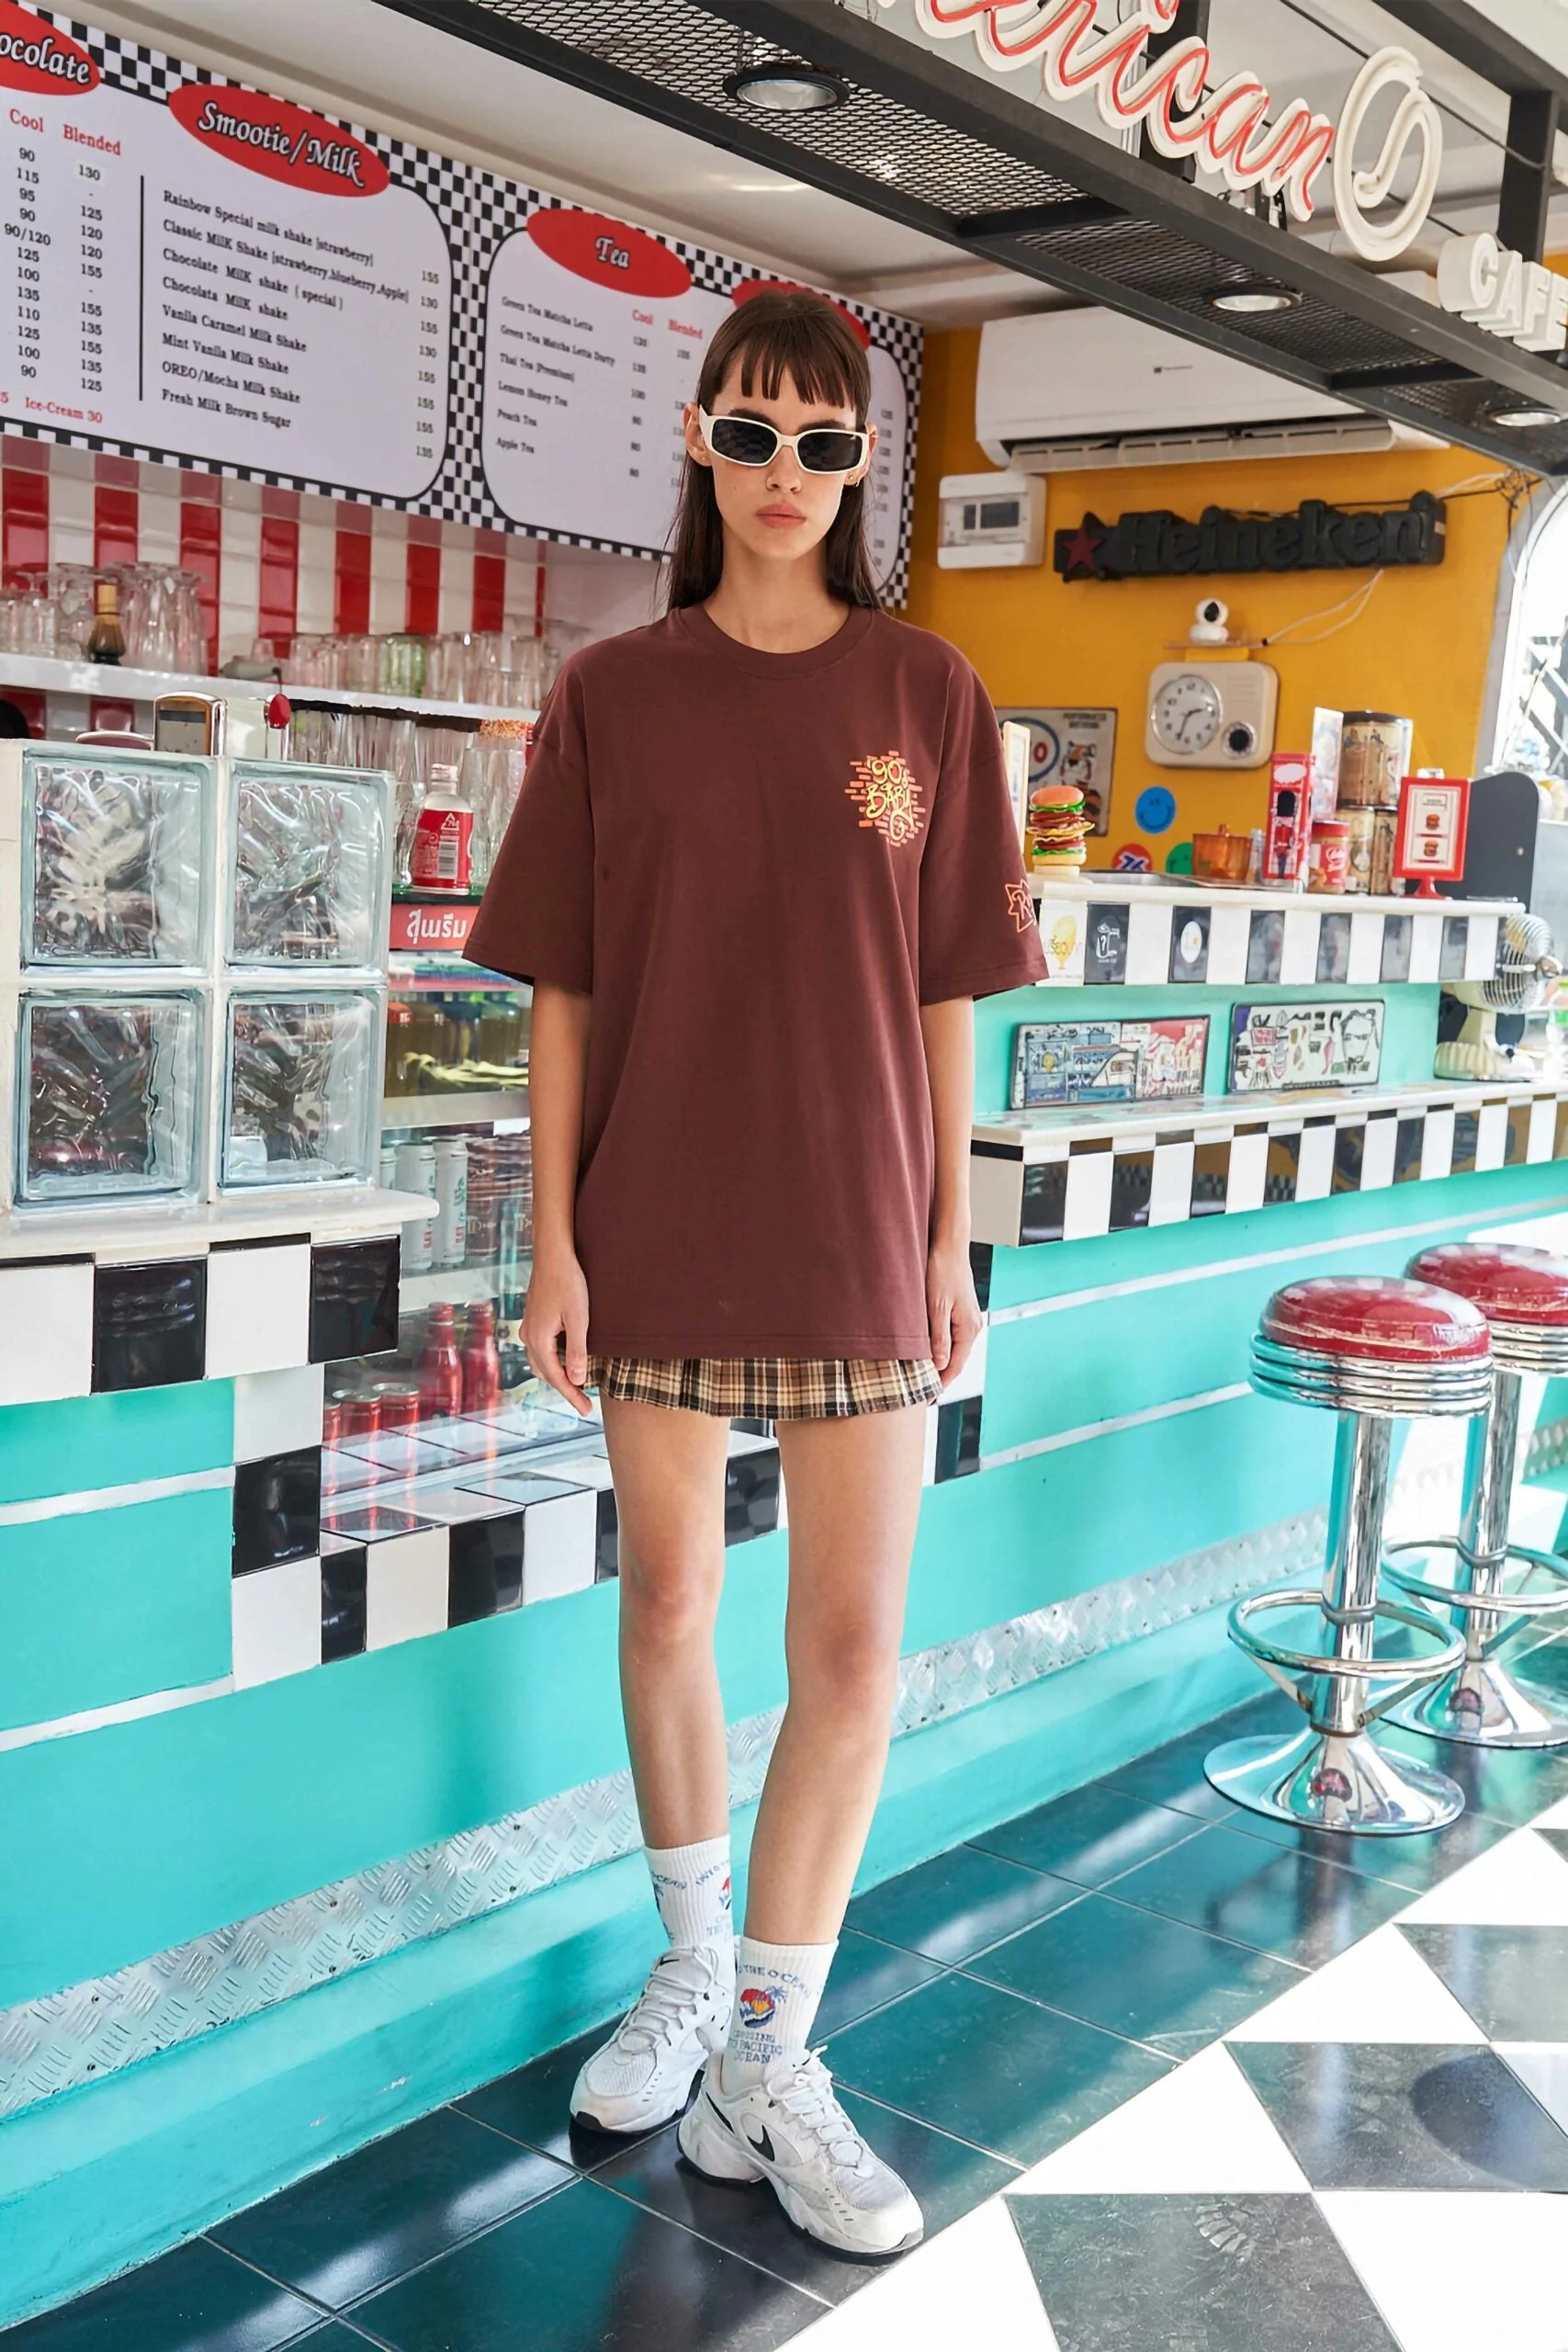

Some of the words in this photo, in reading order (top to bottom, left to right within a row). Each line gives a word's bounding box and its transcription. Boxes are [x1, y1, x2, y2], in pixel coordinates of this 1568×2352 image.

[9, 108, 44, 133] Cool
[62, 124, 122, 156] Blended
[197, 101, 365, 187] Smootie/Milk
[17, 167, 39, 185] 115
[18, 147, 36, 163] 90
[79, 164, 101, 181] 130
[19, 187, 36, 202] 95
[81, 205, 103, 221] 125
[164, 189, 211, 215] Rainbow
[215, 206, 254, 229] Special
[19, 208, 36, 222] 90
[81, 224, 103, 241] 120
[164, 219, 202, 241] Classic
[236, 240, 268, 260] Shake
[4, 222, 51, 245] 90/120
[81, 243, 103, 260] 120
[595, 236, 629, 268] Tea
[17, 246, 39, 263] 125
[81, 263, 103, 278] 155
[17, 266, 40, 282] 100
[163, 247, 219, 274] Chocolate
[17, 286, 40, 301] 135
[81, 301, 103, 317] 155
[17, 305, 40, 322] 110
[81, 321, 103, 336] 135
[201, 314, 245, 336] Caramel
[276, 334, 307, 352] Shake
[668, 318, 704, 340] Blended
[17, 325, 40, 341] 125
[81, 340, 103, 356] 155
[162, 332, 189, 349] Mint
[257, 356, 289, 374] Shake
[17, 345, 40, 360] 100
[81, 358, 103, 374] 135
[20, 365, 37, 379] 90
[81, 378, 103, 393] 125
[269, 386, 300, 403] Shake
[25, 396, 84, 420] Ice-Cream
[87, 410, 103, 424] 30
[162, 388, 194, 406] Fresh
[225, 402, 258, 421] Brown
[1122, 502, 1429, 573] Heineken
